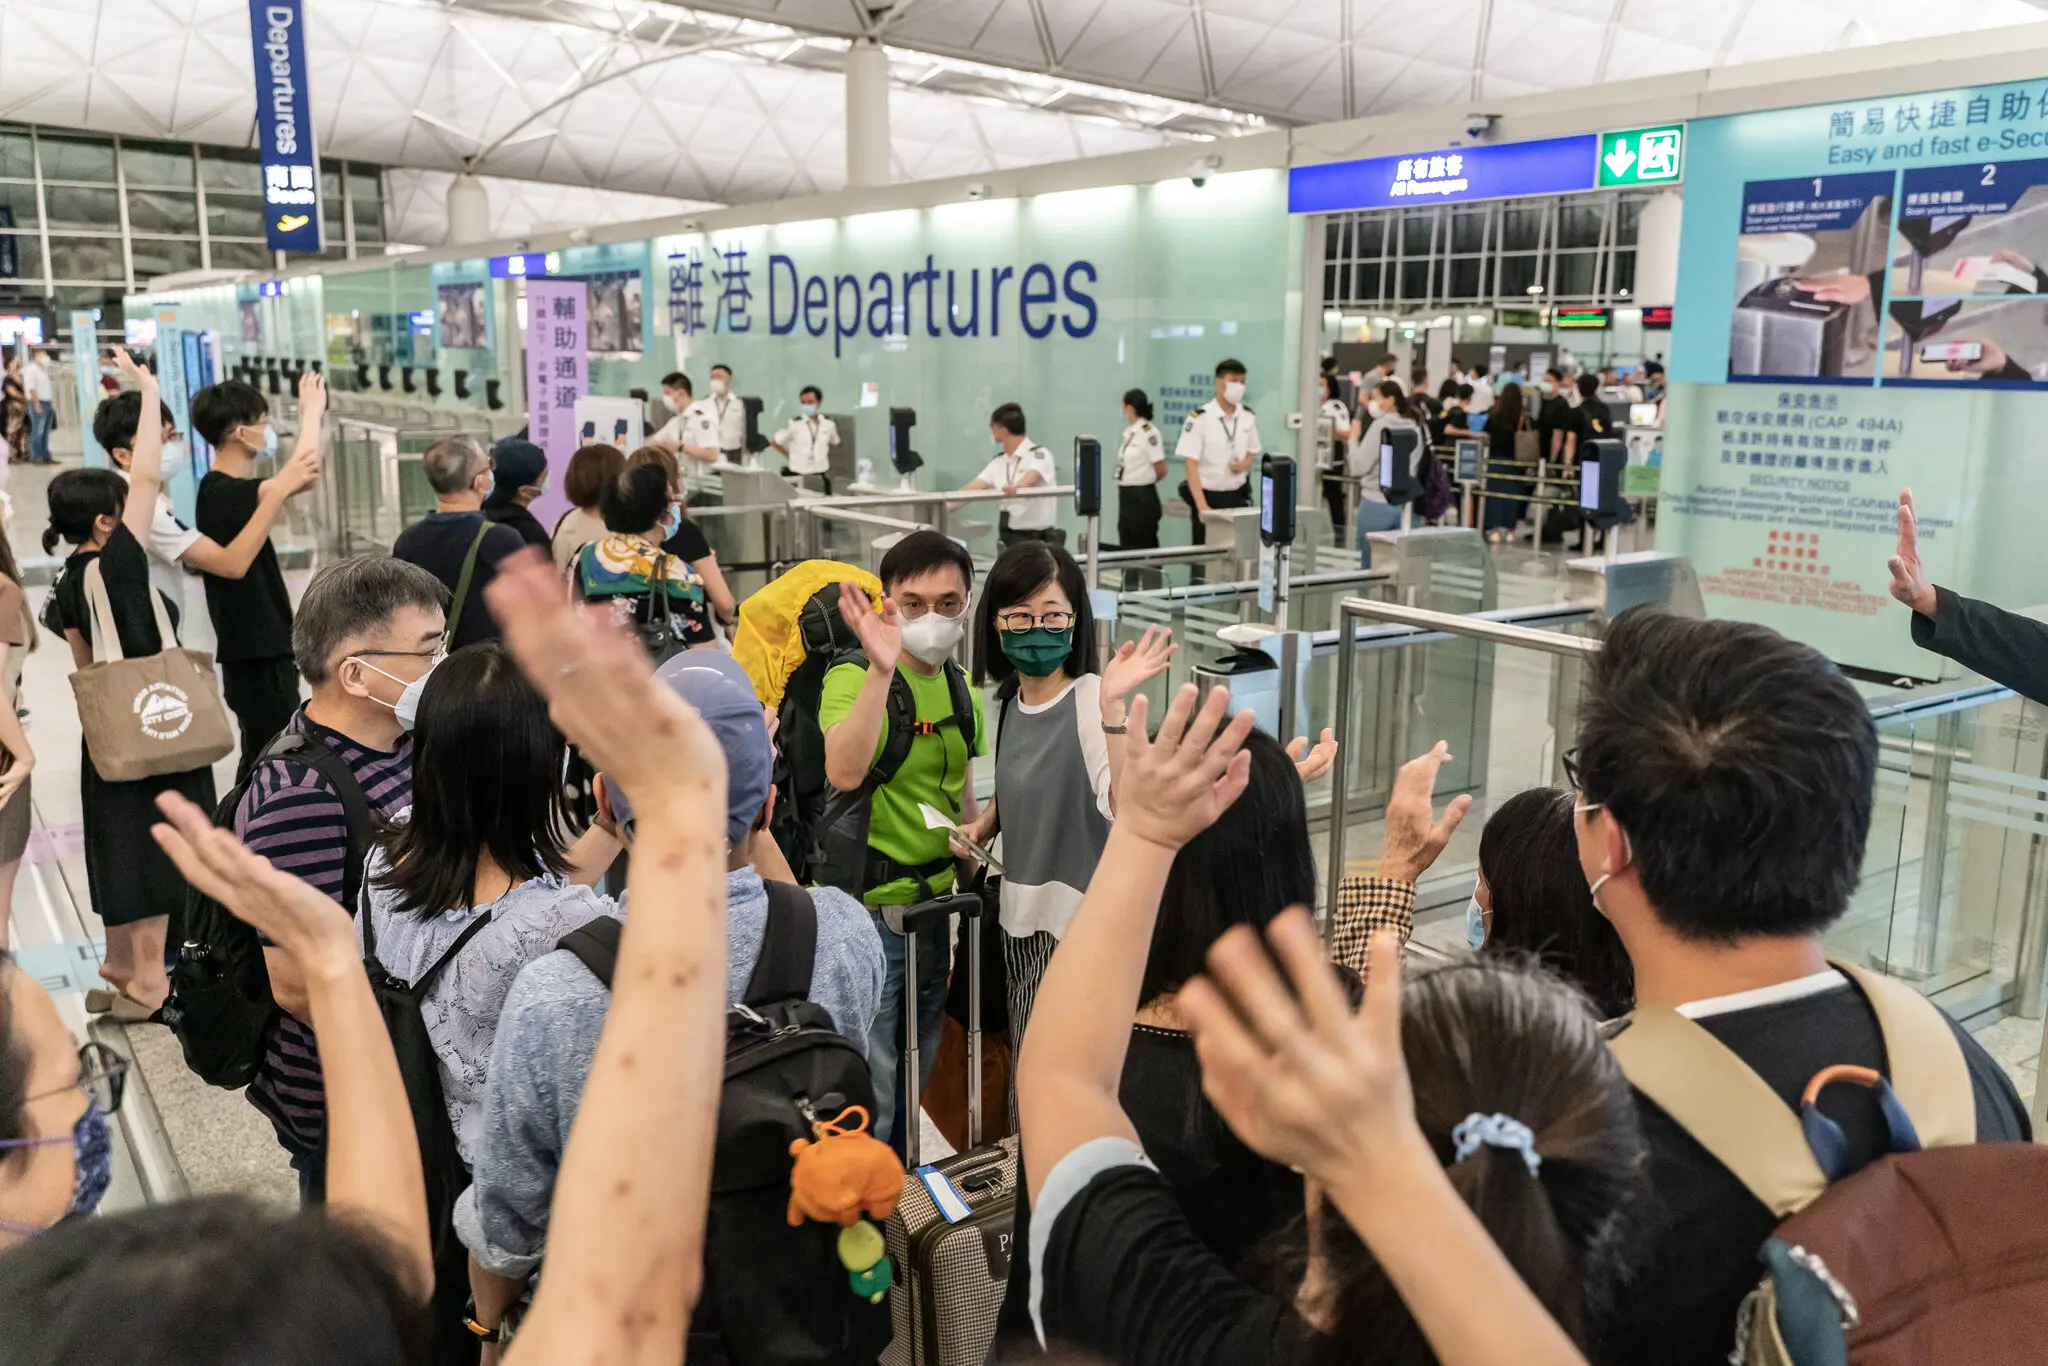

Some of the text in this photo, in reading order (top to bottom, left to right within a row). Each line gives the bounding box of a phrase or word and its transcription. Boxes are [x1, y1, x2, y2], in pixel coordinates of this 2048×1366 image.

[263, 6, 297, 155] Departures
[1828, 145, 1877, 166] Easy
[1882, 138, 1924, 160] and
[1930, 135, 1970, 156] fast
[1981, 163, 1997, 186] 2
[1812, 177, 1823, 198] 1
[667, 241, 752, 337] 離港
[768, 253, 1099, 358] Departures
[552, 296, 579, 410] 輔助通道
[1749, 473, 1851, 493] SECURITY NOTICE
